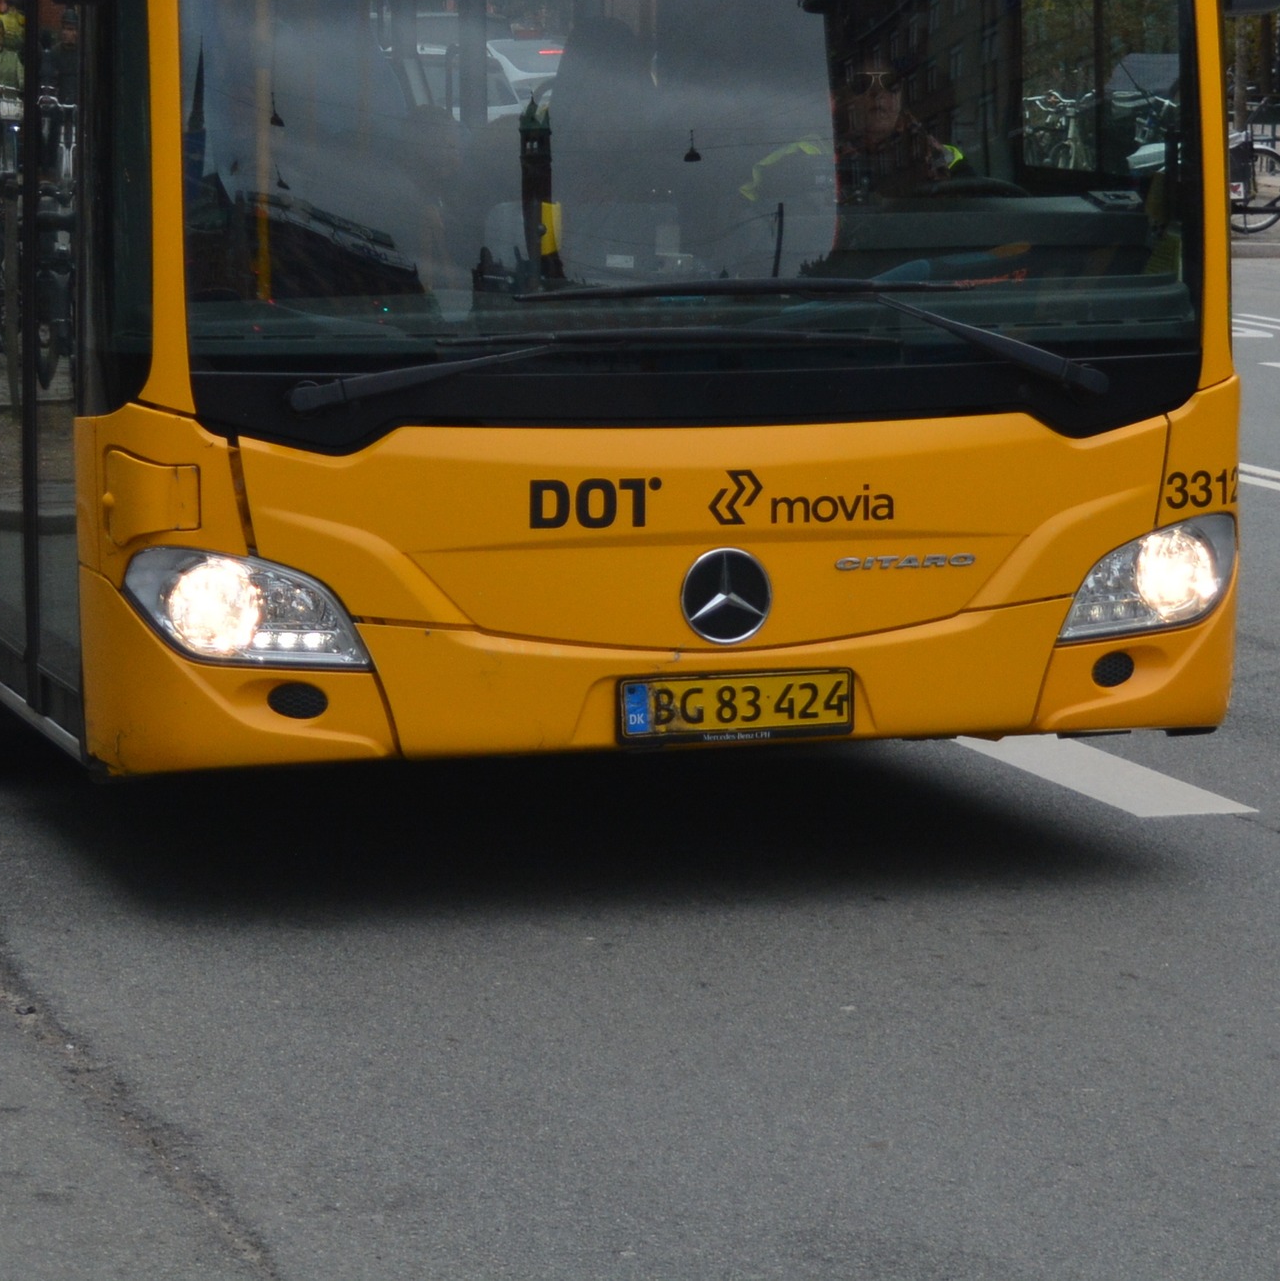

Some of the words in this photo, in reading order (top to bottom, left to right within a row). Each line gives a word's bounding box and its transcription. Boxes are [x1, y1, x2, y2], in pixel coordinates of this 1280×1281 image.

[529, 477, 662, 530] DOT
[770, 484, 895, 524] movia
[835, 552, 976, 572] CITARO
[653, 687, 705, 726] BG
[715, 685, 762, 724] 83
[773, 680, 846, 720] 424
[629, 713, 645, 725] DK
[755, 730, 771, 740] CPH
